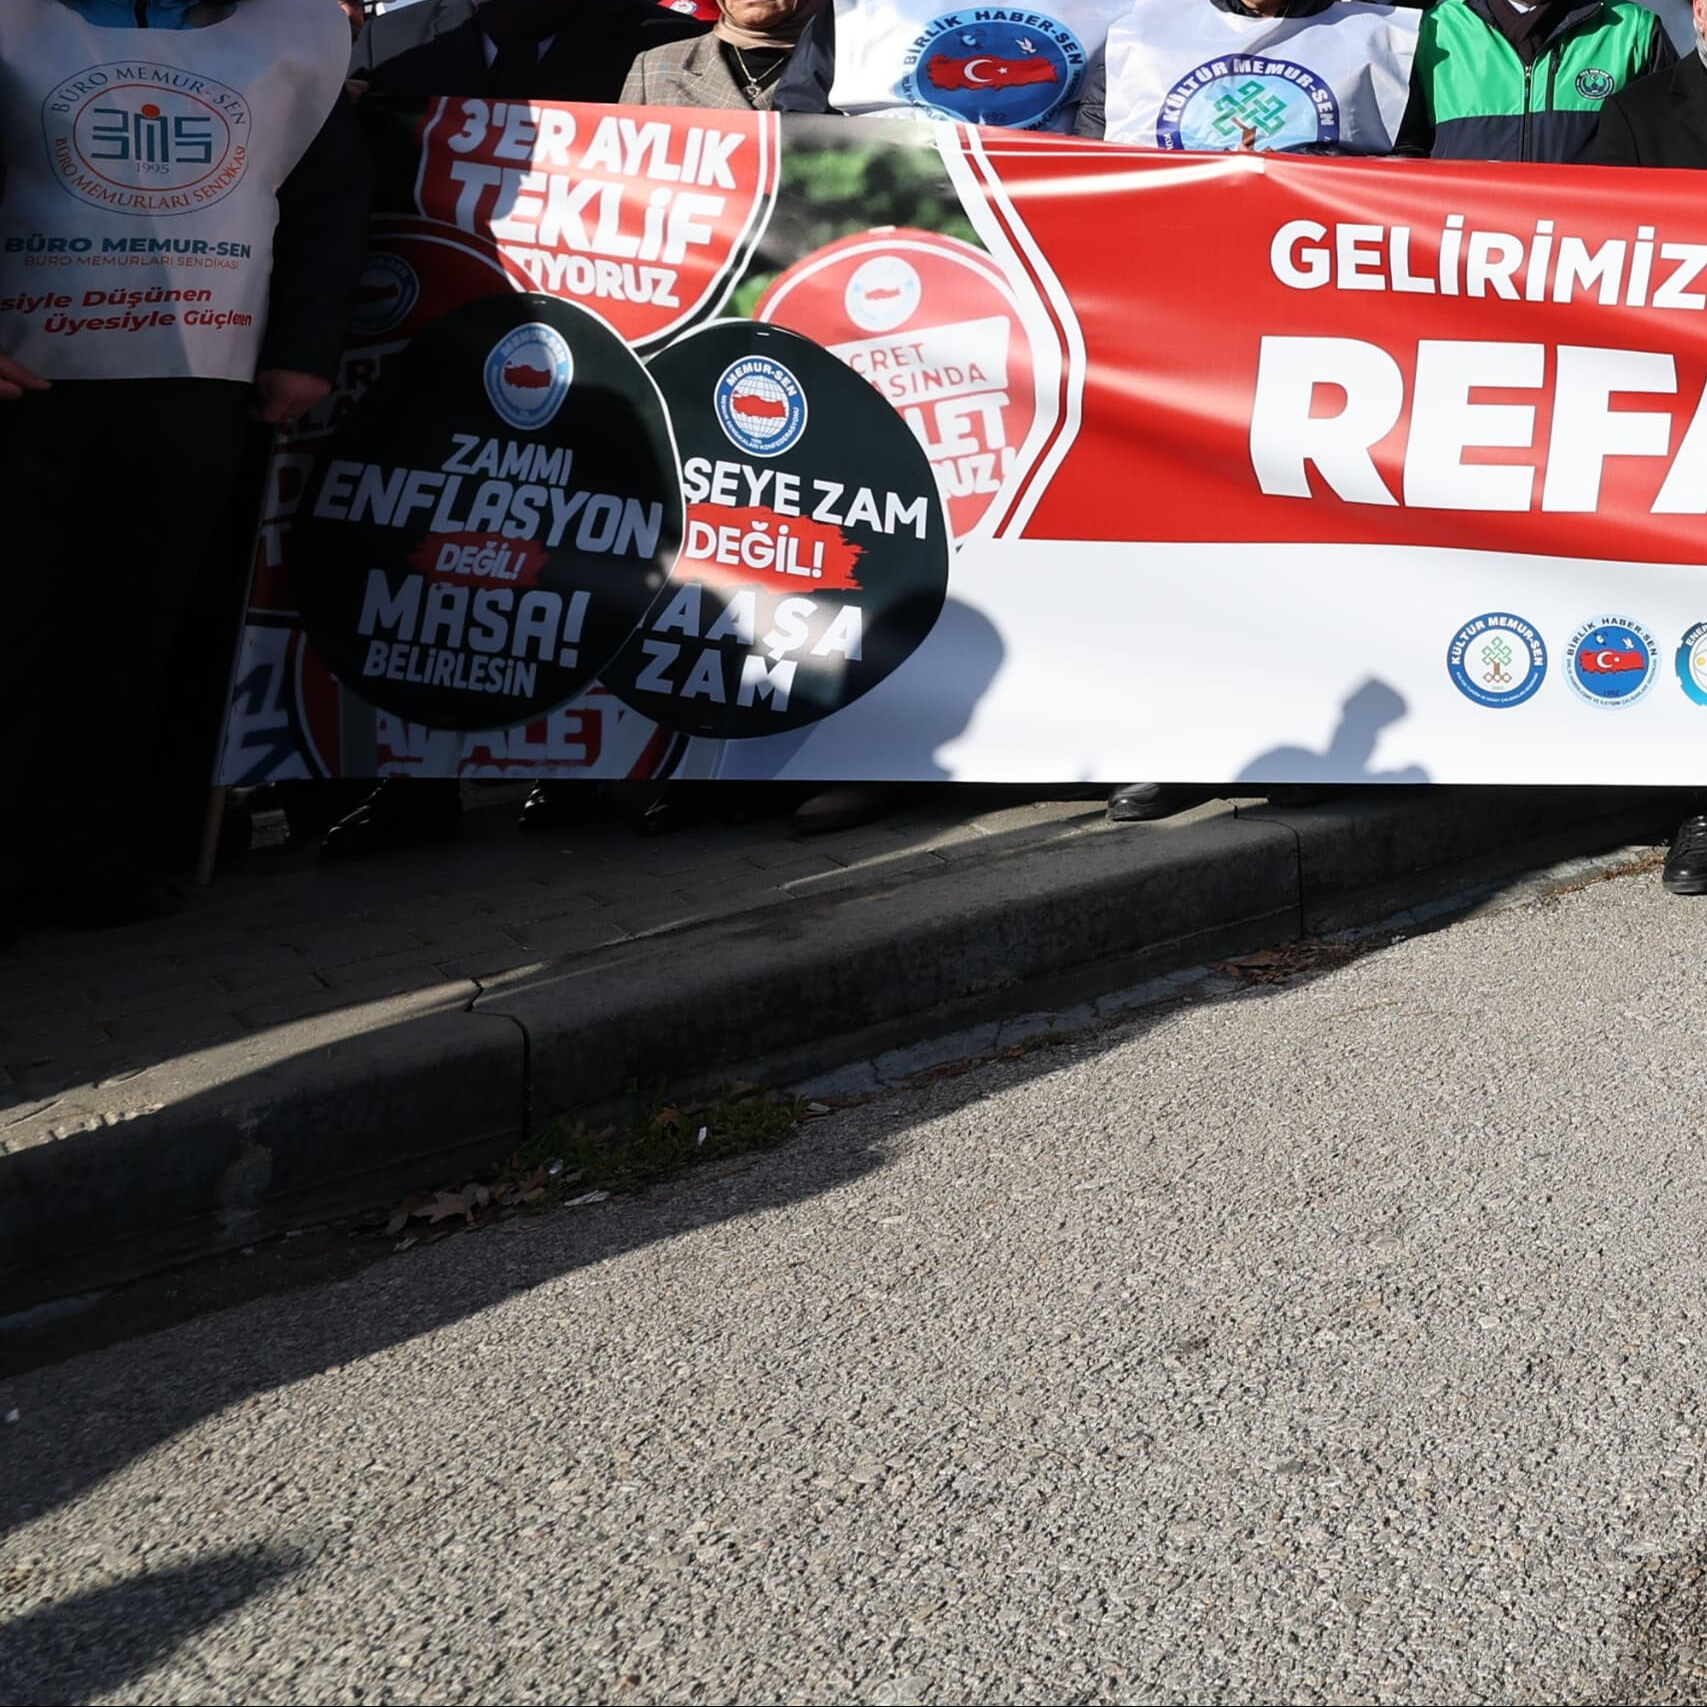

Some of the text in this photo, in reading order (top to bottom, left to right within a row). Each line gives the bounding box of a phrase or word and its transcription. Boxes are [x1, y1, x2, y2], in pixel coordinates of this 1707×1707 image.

[903, 10, 1084, 65] BİRLİK HABER-SEN
[51, 72, 109, 114] BÜRO
[1162, 59, 1336, 127] KÜLTÜR MEMUR-SEN
[55, 137, 246, 210] BÜRO MEMURLARI SENDİKASI
[135, 162, 169, 175] 1995
[580, 116, 746, 190] AYLIK
[451, 160, 725, 265] TEKLİF
[4, 233, 251, 259] BÜRO MEMUR-SEN
[77, 256, 173, 268] MEMURLARI
[43, 311, 176, 336] Üyesiyle
[81, 287, 212, 309] Düşünen
[442, 433, 573, 485] ZAMMI
[313, 461, 663, 559] ENFLASYON
[812, 479, 928, 539] ZAM
[435, 539, 525, 582] DEĞİL!
[685, 520, 824, 578] DEĞİL!
[358, 569, 591, 669] MASA!
[1487, 615, 1545, 667] MEMUR-SEN
[364, 640, 537, 698] BELİRLESİN
[635, 639, 797, 712] ZAM
